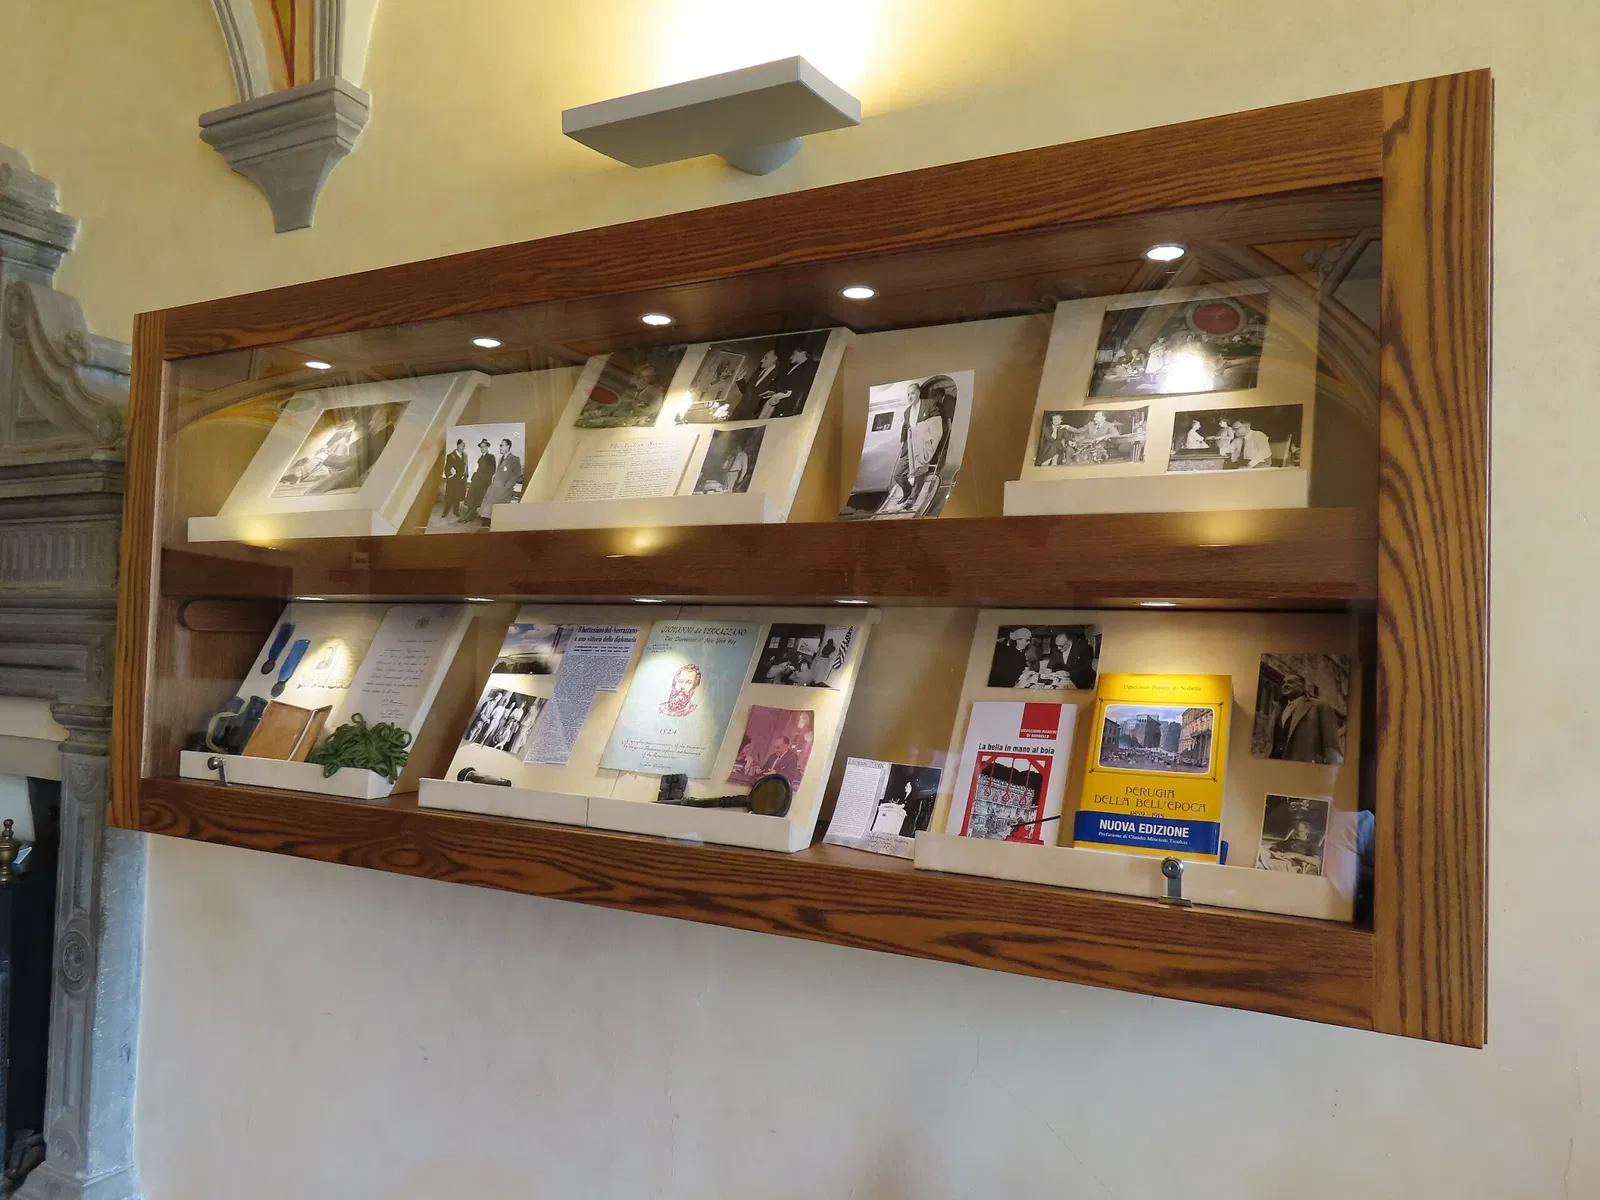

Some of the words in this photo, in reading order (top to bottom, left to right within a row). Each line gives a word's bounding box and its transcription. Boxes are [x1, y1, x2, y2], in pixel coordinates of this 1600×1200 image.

[660, 625, 694, 634] GIOVANNI
[701, 627, 747, 636] VERRAZZANO
[614, 635, 637, 643] diplomazia
[987, 743, 1003, 751] bella
[1004, 743, 1011, 751] in
[1032, 746, 1039, 754] al
[1040, 746, 1055, 754] boia
[1125, 786, 1175, 799] PERUGIA
[1094, 794, 1130, 806] DELLA
[1099, 819, 1136, 833] NUOVA
[1139, 823, 1190, 838] EDIZIONE
